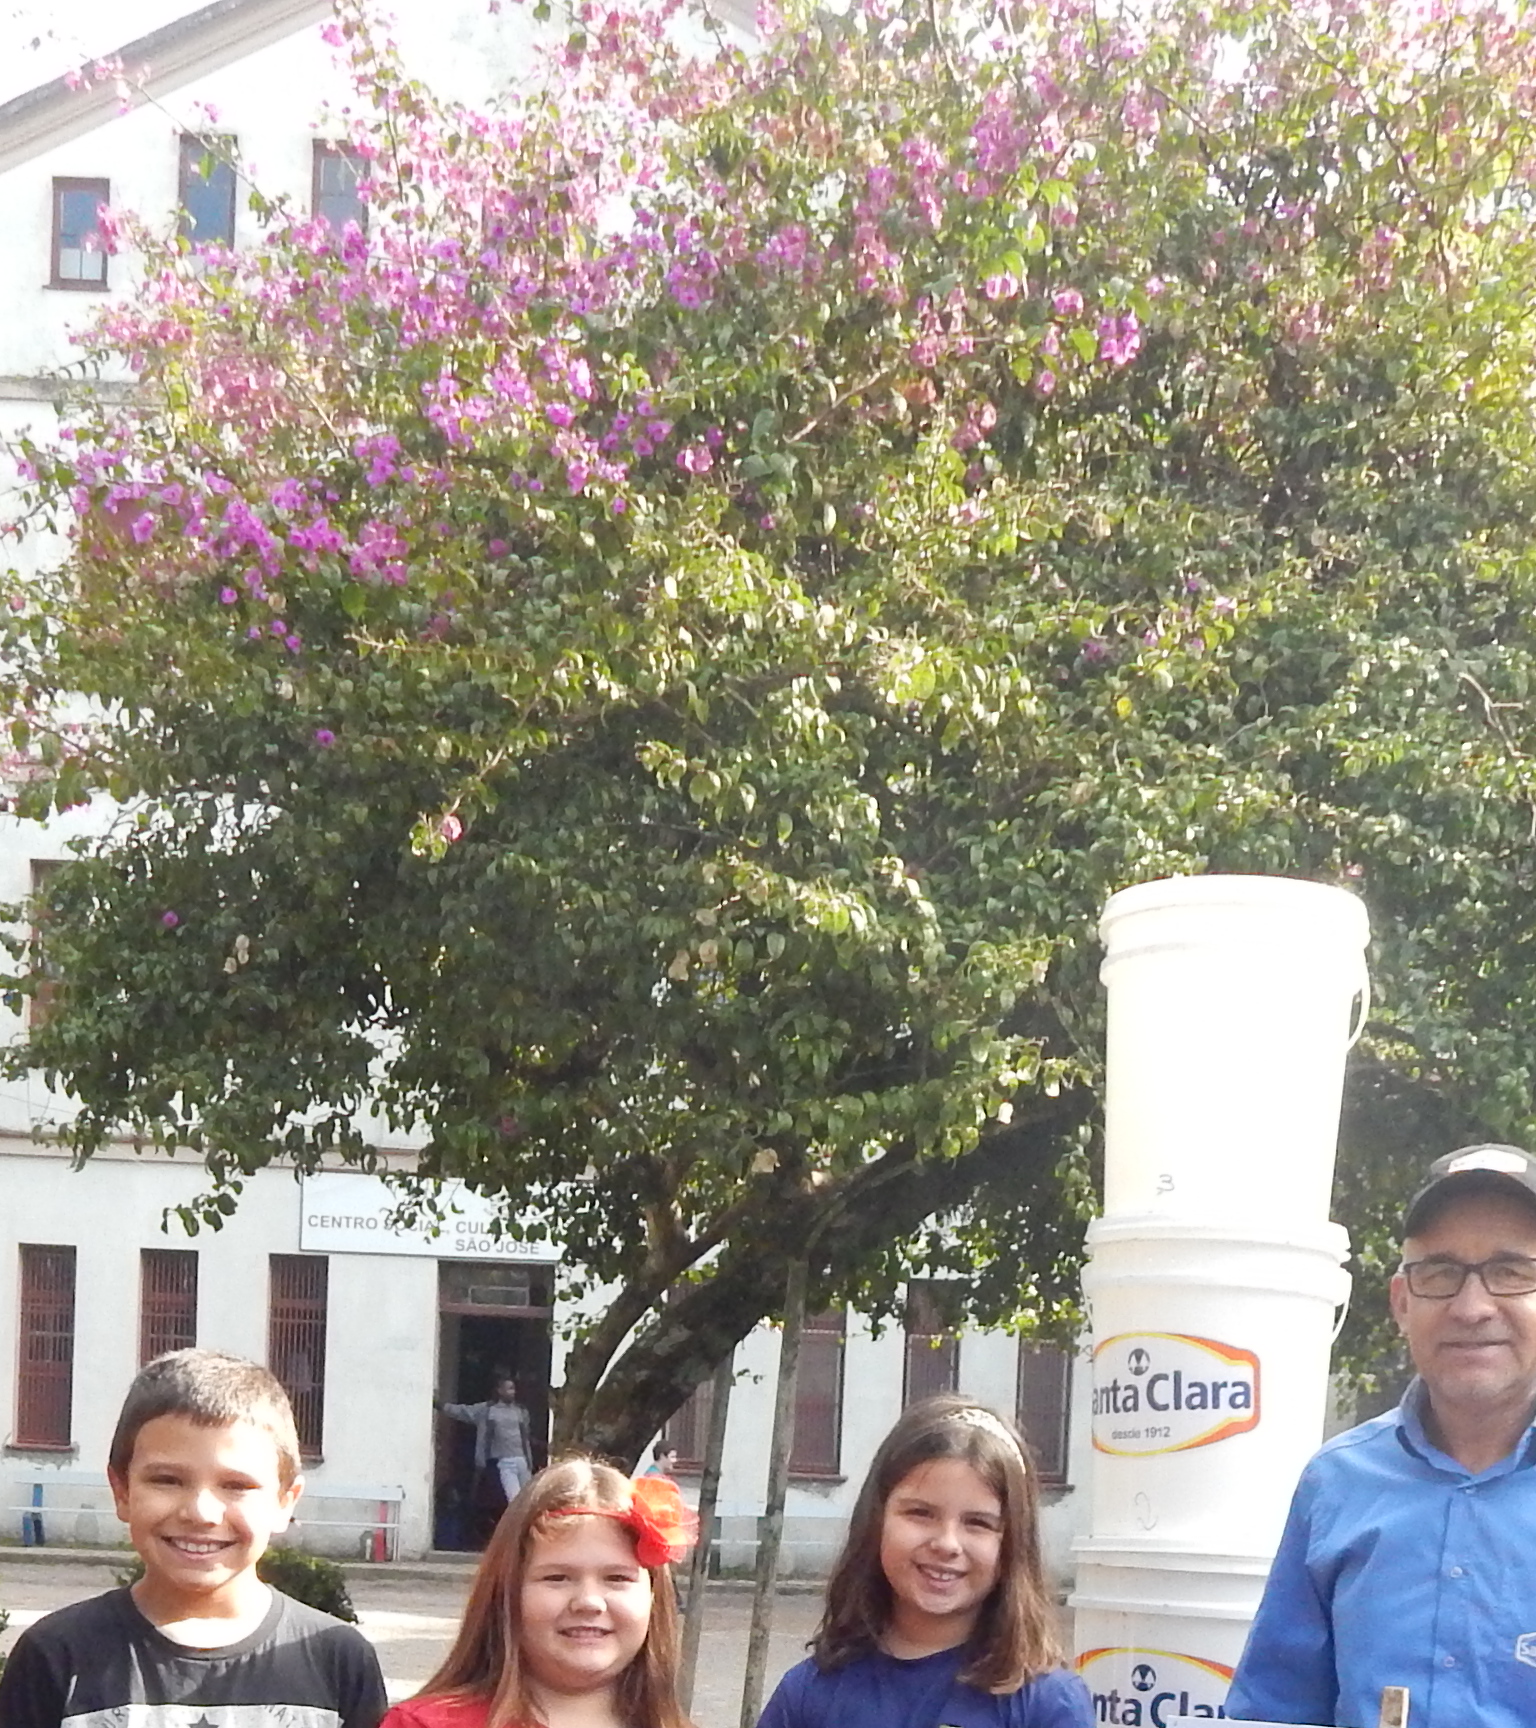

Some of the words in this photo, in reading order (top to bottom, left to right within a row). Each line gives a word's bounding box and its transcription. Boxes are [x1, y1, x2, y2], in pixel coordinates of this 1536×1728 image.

[307, 1214, 378, 1230] CENTRO
[455, 1236, 491, 1252] SÃO
[1092, 1377, 1139, 1415] anta
[1145, 1370, 1251, 1411] Clara
[1111, 1427, 1141, 1439] desde
[1145, 1426, 1171, 1438] 1912
[1093, 1689, 1142, 1727] nta
